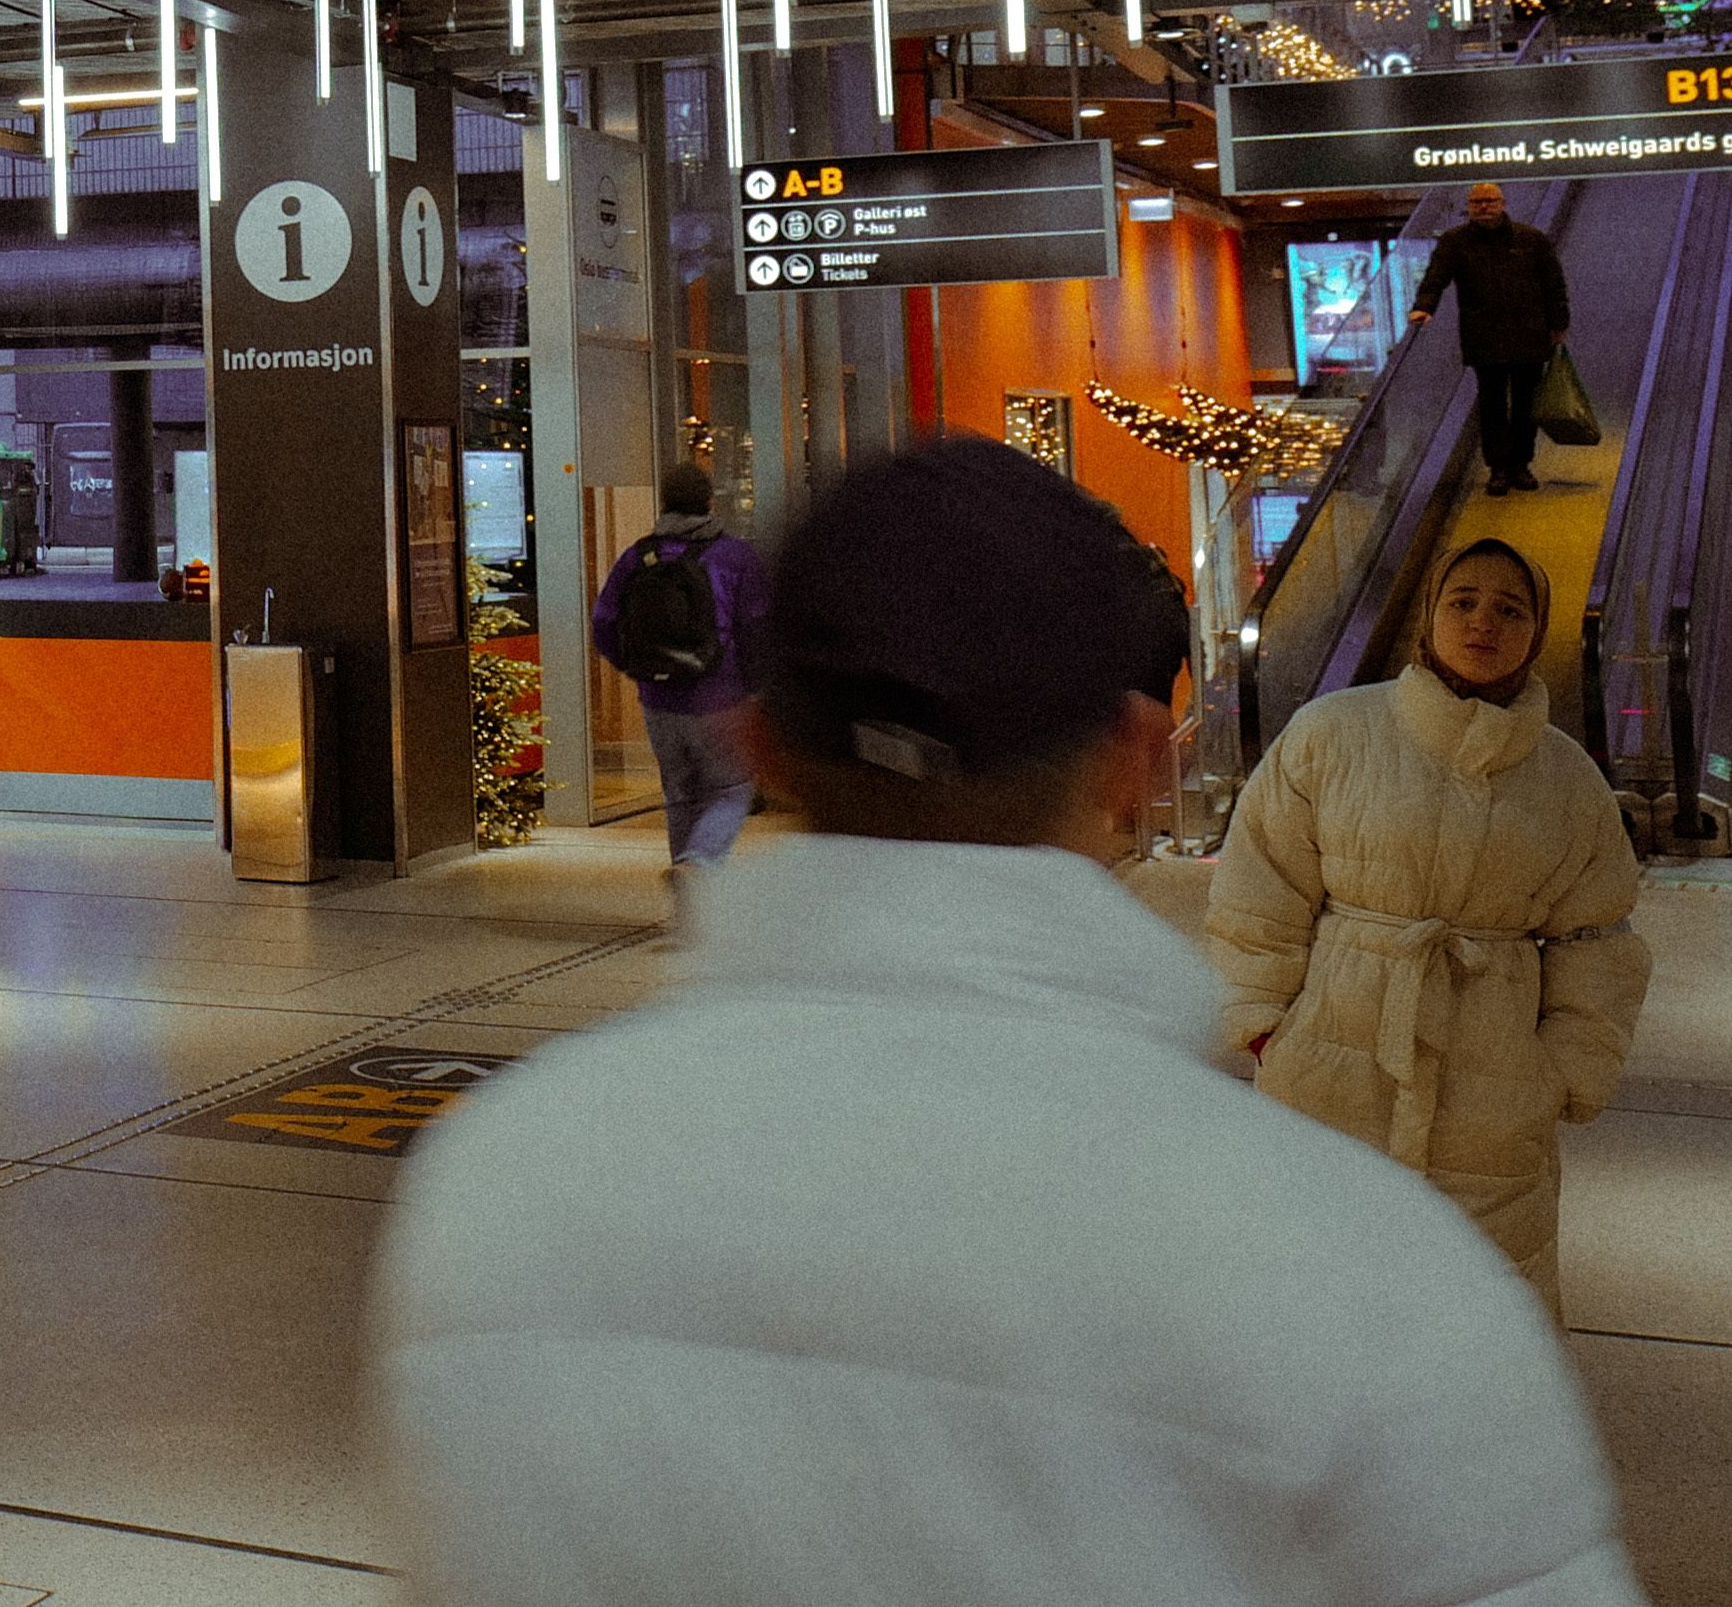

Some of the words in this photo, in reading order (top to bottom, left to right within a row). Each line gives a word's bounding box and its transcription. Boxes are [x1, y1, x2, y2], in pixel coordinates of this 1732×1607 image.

[1413, 141, 1535, 168] Grønland,
[1539, 130, 1717, 160] Schweigaards
[782, 166, 844, 199] A-B
[853, 205, 903, 220] Galleri
[904, 204, 928, 218] øst
[853, 221, 897, 236] P-hus
[820, 251, 881, 267] Billetter
[821, 267, 869, 282] Tickets
[222, 343, 374, 373] Informasjon
